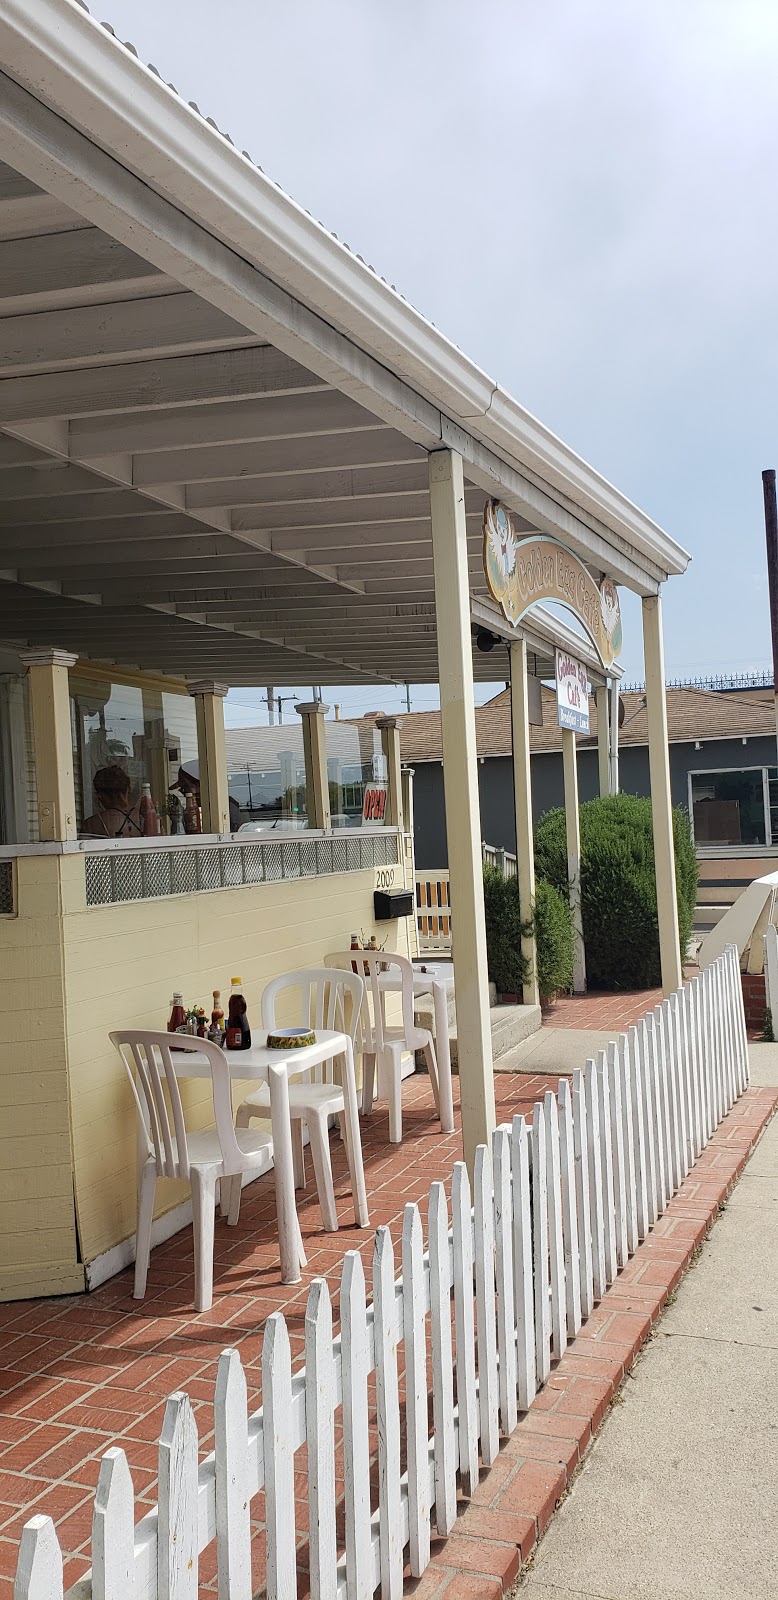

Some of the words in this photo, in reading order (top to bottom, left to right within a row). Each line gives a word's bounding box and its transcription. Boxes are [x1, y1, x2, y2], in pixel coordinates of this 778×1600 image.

[516, 547, 554, 602] Golden
[555, 550, 577, 602] Egg
[557, 651, 577, 682] Golden
[577, 662, 588, 702] Egg
[560, 707, 577, 727] Breakfast
[363, 789, 387, 821] OPEN
[376, 868, 395, 889] 2009
